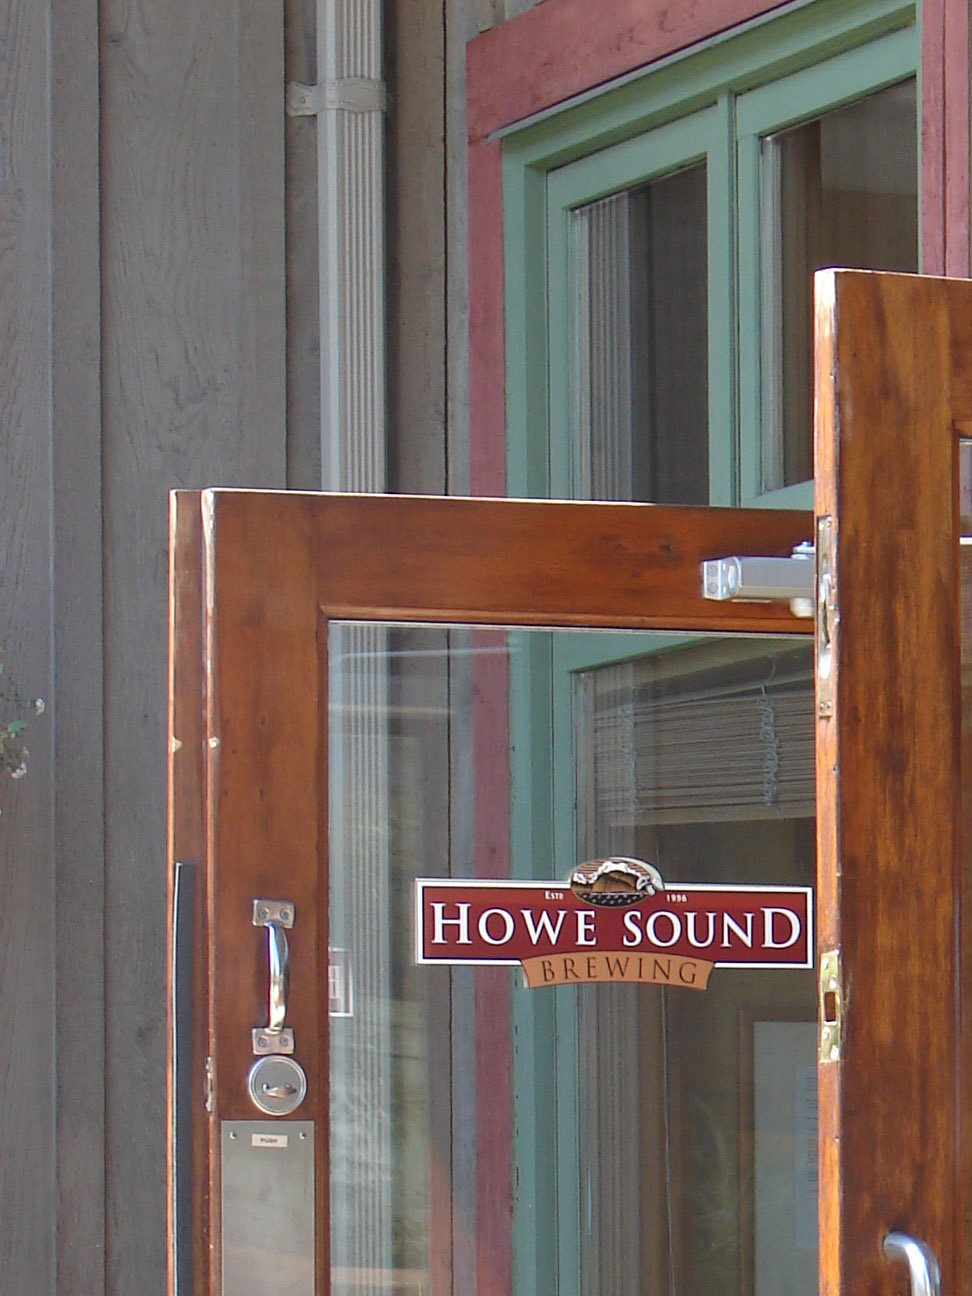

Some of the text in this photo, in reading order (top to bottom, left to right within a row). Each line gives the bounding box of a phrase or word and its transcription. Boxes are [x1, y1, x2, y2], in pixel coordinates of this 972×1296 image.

[430, 902, 801, 949] HOWE SOUND
[542, 955, 698, 986] BREWING
